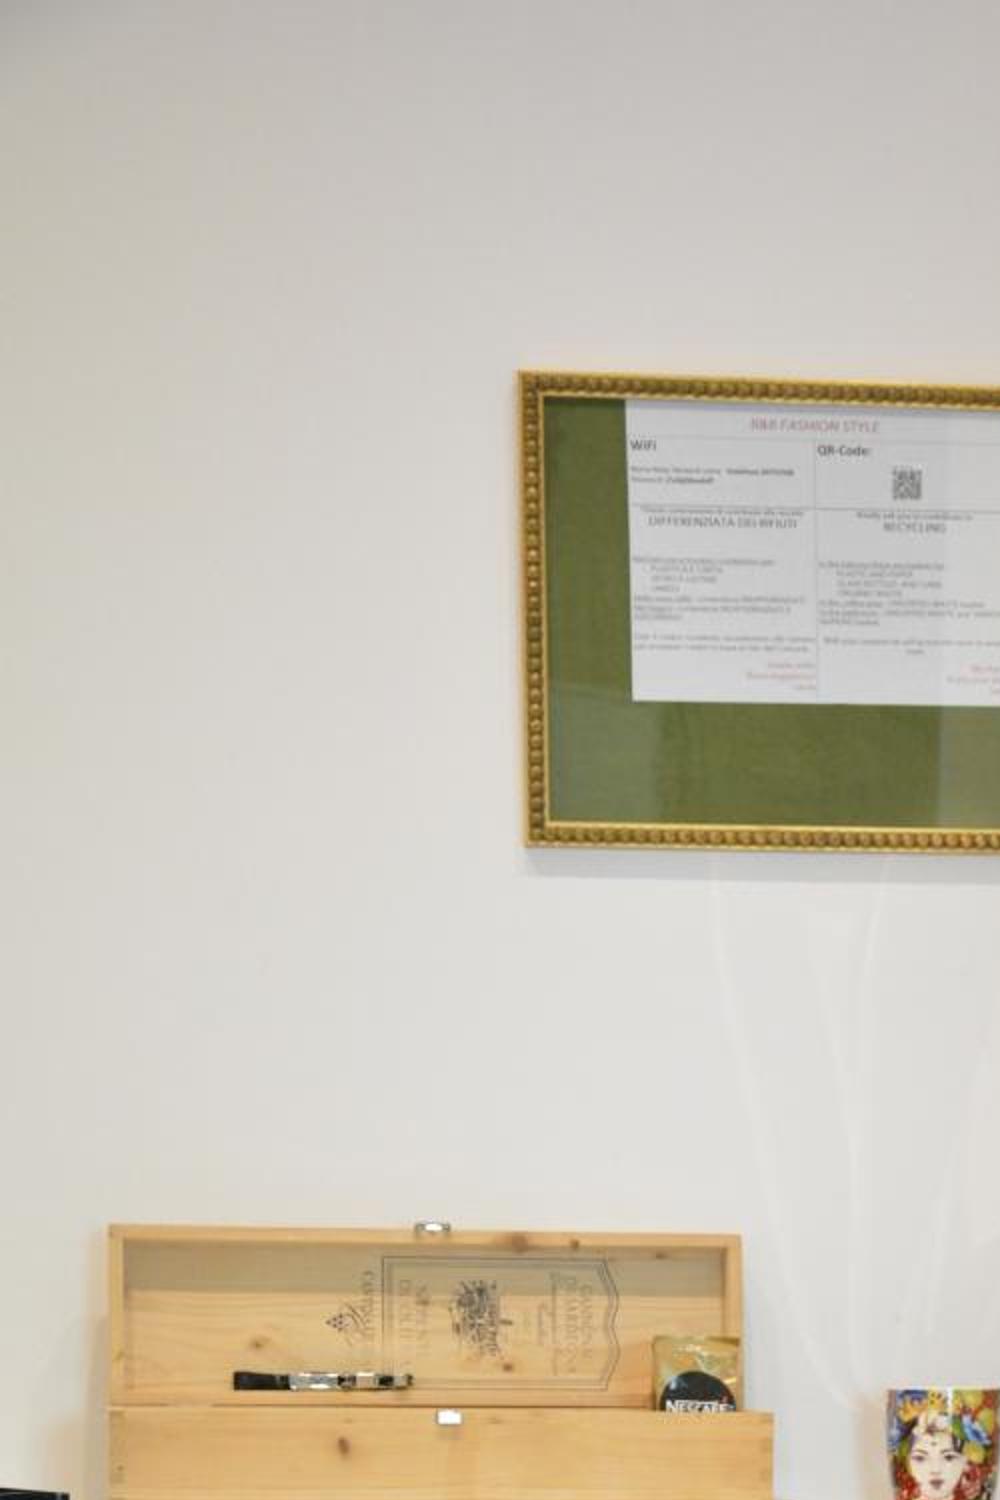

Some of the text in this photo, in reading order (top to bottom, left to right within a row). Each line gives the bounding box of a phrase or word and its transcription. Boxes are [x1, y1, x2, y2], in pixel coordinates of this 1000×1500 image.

[780, 417, 841, 432] FASHION
[844, 419, 879, 433] STYLE
[882, 521, 947, 533] RECYCLING
